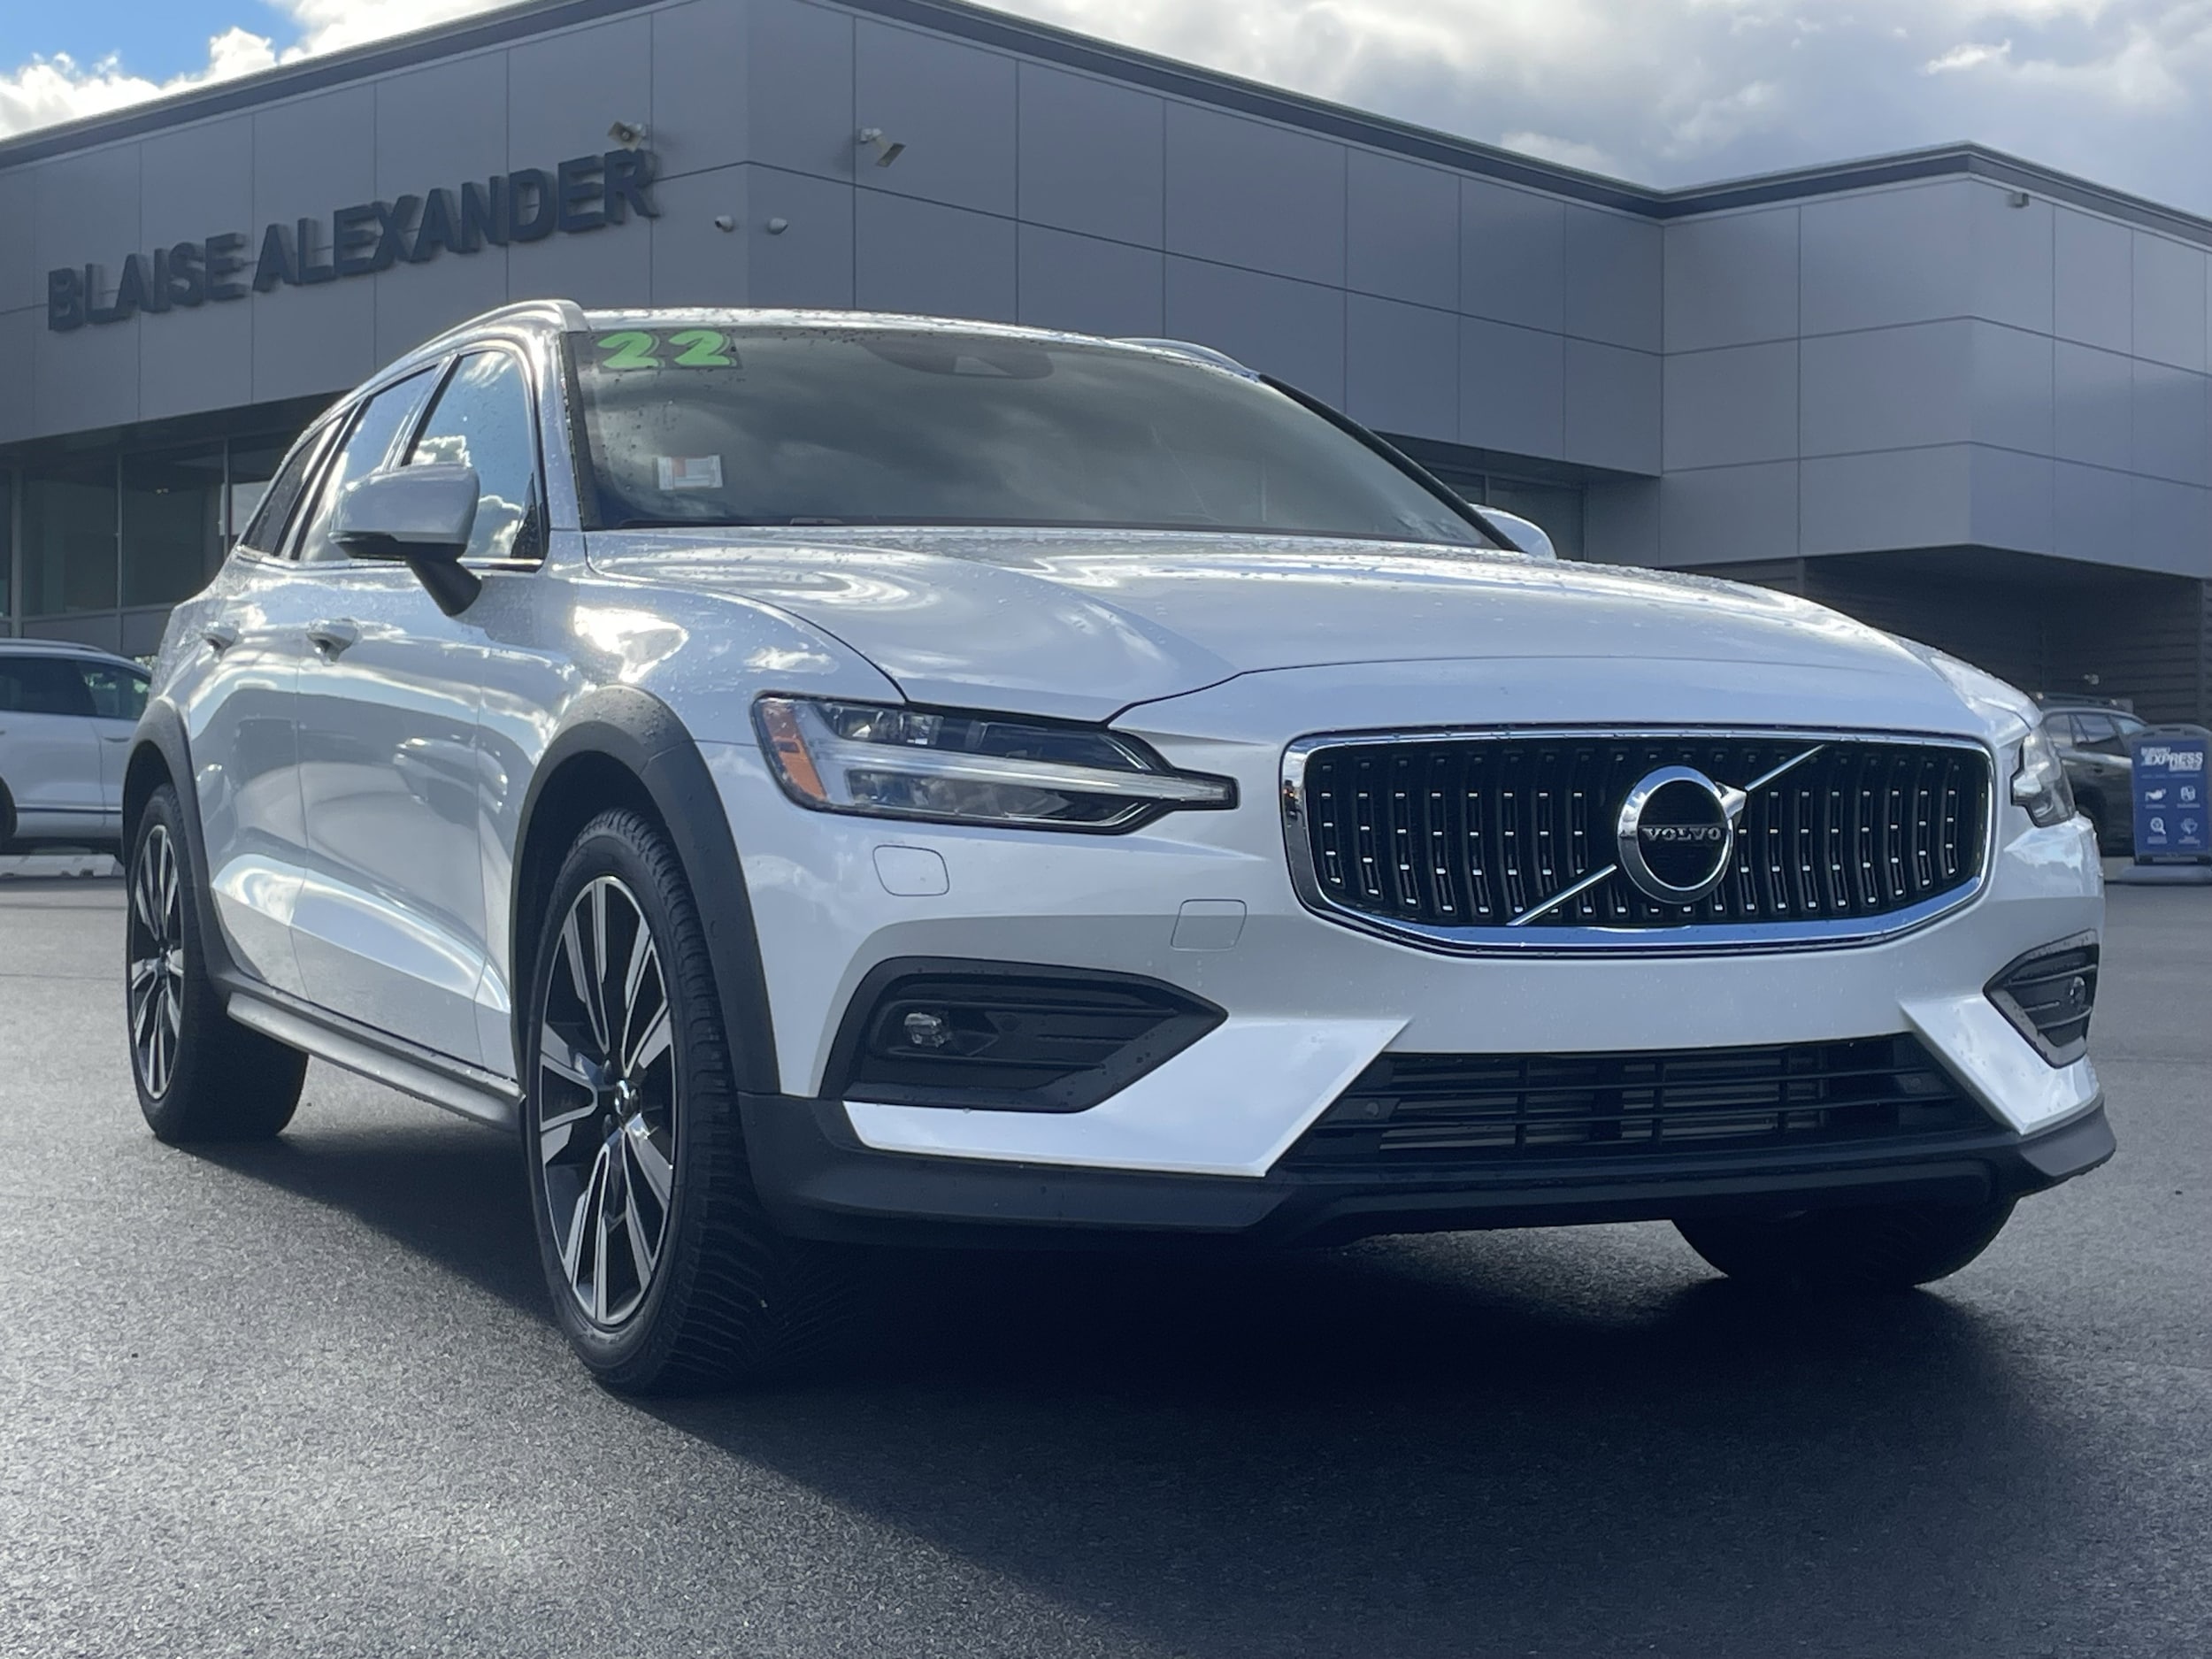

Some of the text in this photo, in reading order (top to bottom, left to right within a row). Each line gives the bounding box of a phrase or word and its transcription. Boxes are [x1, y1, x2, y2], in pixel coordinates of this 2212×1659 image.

[49, 149, 661, 332] BLAISE ALEXANDER
[597, 329, 737, 369] 22
[1643, 827, 1722, 841] VOLVO
